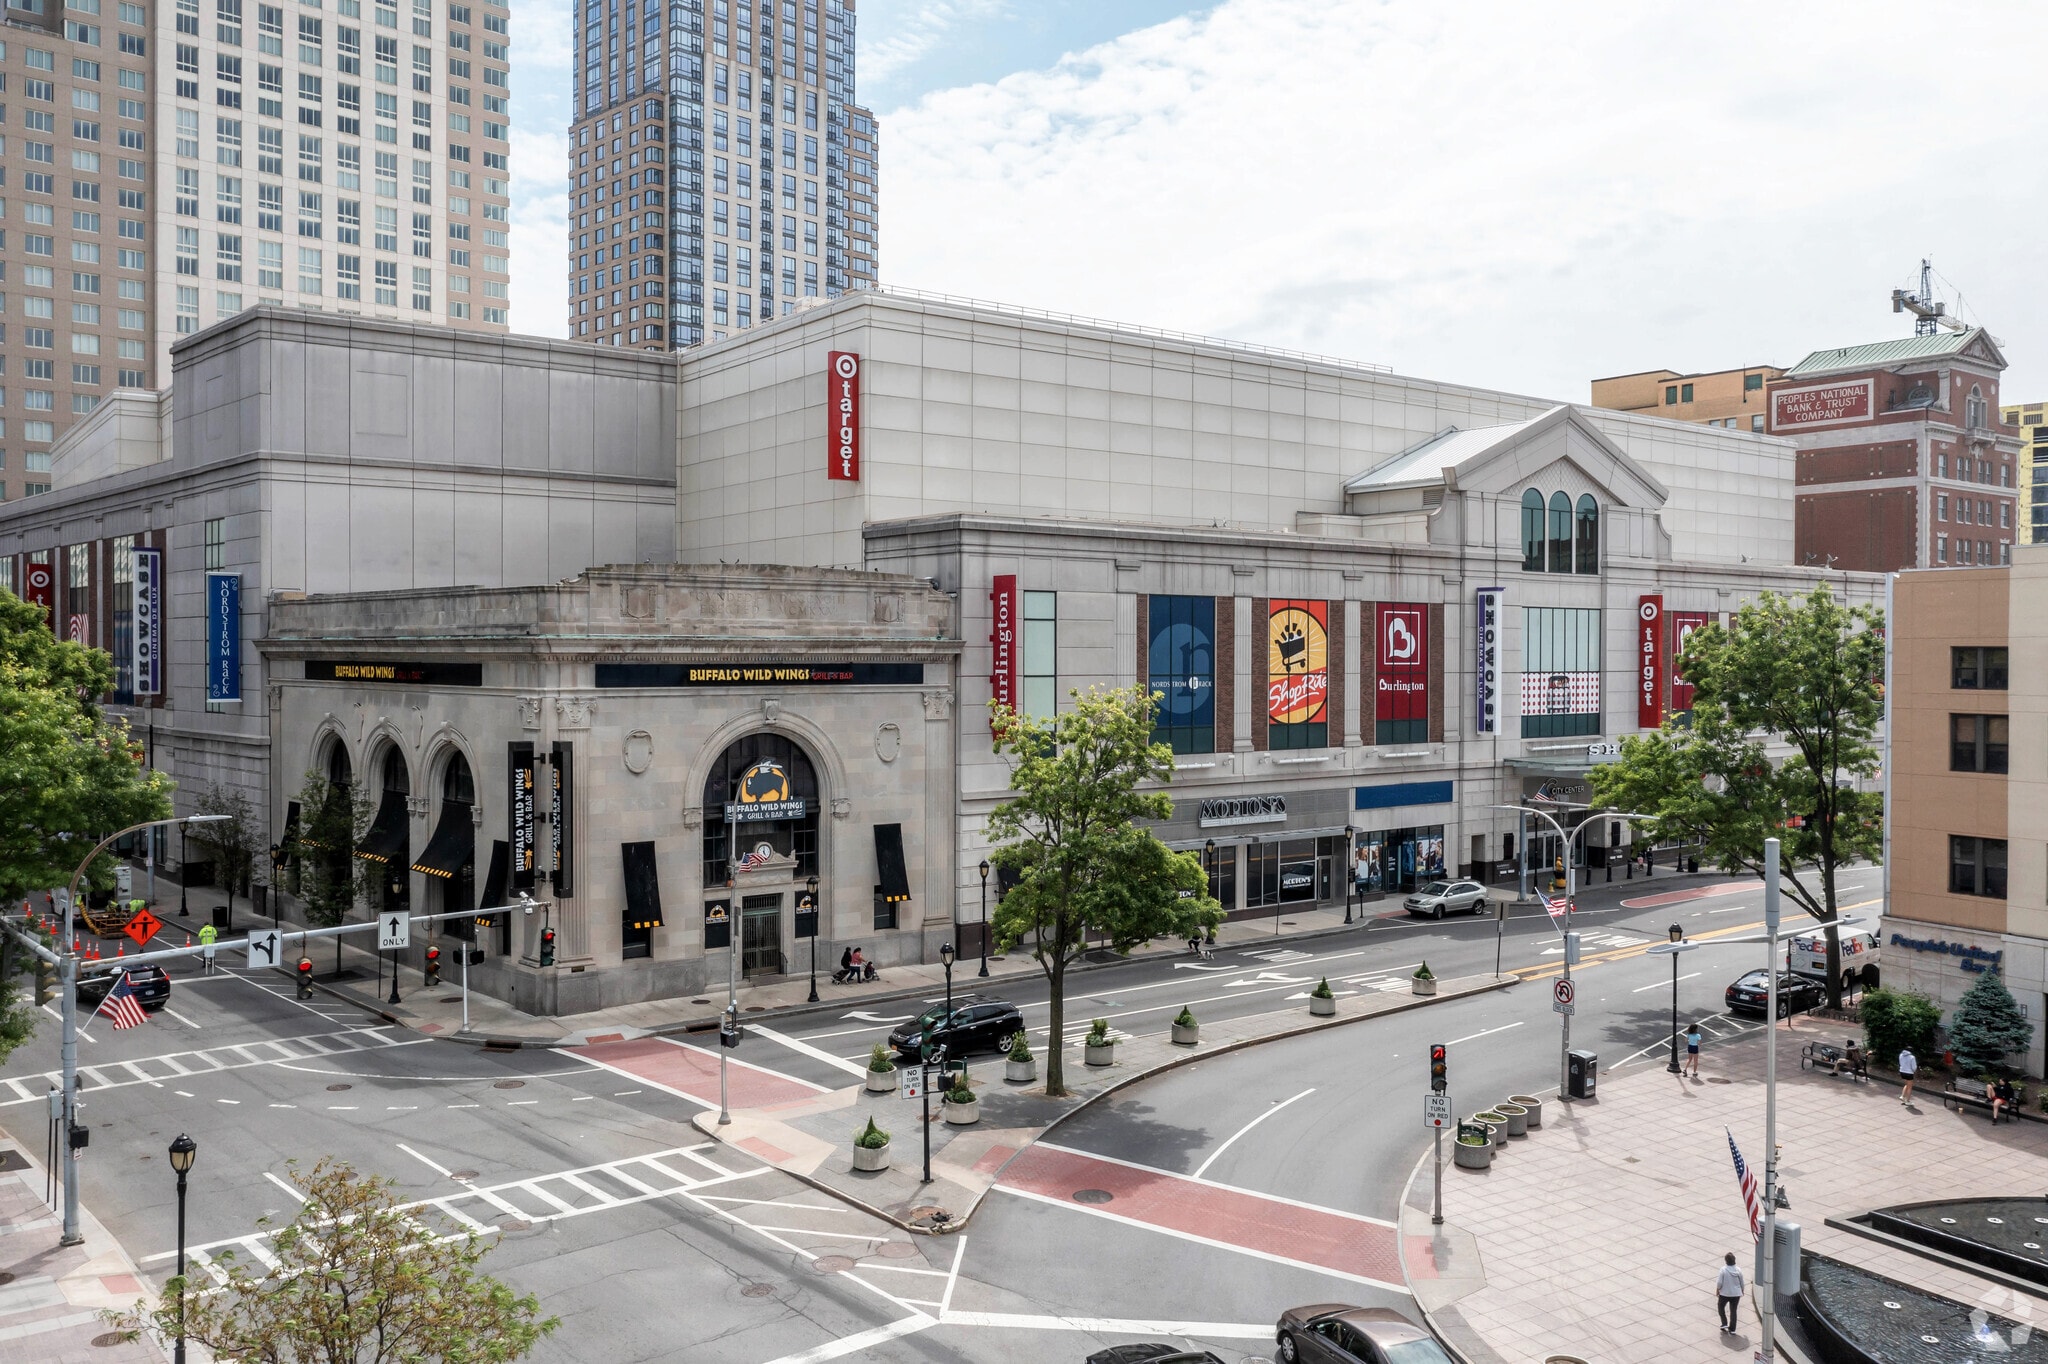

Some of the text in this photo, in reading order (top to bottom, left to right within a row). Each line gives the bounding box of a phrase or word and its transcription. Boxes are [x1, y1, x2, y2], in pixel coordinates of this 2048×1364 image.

[1778, 386, 1866, 405] PEOPLES NATIONAL
[1786, 396, 1857, 414] BANK & TRUST
[1795, 407, 1845, 422] COMPANY
[840, 380, 853, 477] target
[139, 554, 149, 692] SHOWCASE
[152, 609, 158, 620] DE
[220, 580, 230, 656] NORDSTROM
[995, 592, 1013, 714] urlington
[335, 665, 359, 678] BUFFALO
[360, 665, 375, 678] WILD
[375, 666, 395, 679] WINGS
[1485, 594, 1495, 732] SHOWCASE
[1643, 627, 1654, 706] target
[689, 669, 741, 681] BUFFALO
[743, 669, 772, 681] WILD
[774, 668, 809, 680] WINGS
[812, 672, 831, 680] GRILL
[839, 672, 853, 680] BAR
[1269, 671, 1327, 711] ShopRite
[1379, 678, 1425, 694] Burlington
[1551, 785, 1585, 795] CITY CENTER
[525, 794, 533, 812] BAR
[726, 801, 803, 813] BFFALO WILD WINGS
[1200, 795, 1286, 818] MORTON'S
[515, 768, 525, 872] BUFFALO WILD WINGS
[747, 812, 763, 820] GRILL
[525, 822, 533, 844] GRILL
[383, 938, 406, 946] ONLY
[1841, 937, 1864, 957] FedEx
[907, 1069, 917, 1077] NO
[1432, 1098, 1445, 1106] NO
